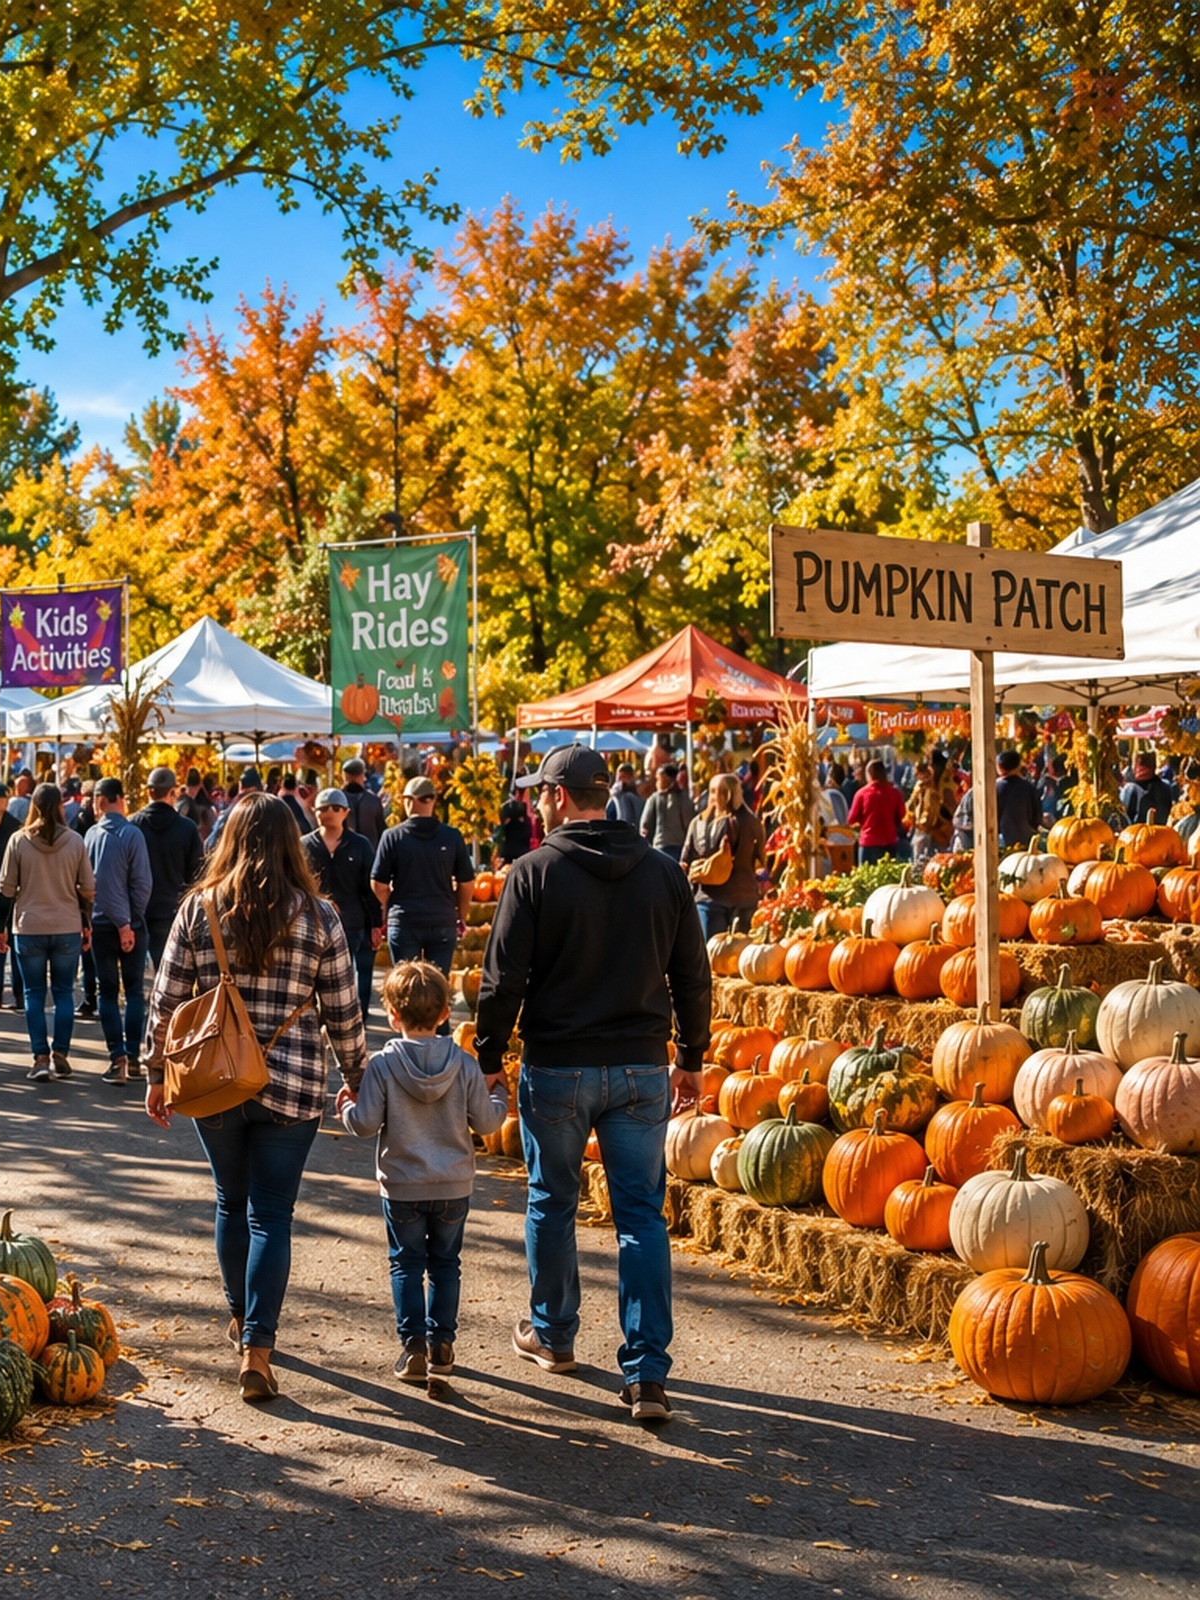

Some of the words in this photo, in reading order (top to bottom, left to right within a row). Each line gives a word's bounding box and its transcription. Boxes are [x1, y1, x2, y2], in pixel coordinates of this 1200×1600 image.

[367, 563, 432, 610] Hay
[793, 550, 973, 624] PUMPKIN
[991, 570, 1107, 635] PATCH
[35, 606, 88, 638] Kids
[351, 607, 449, 651] Rides
[10, 642, 111, 671] Activities
